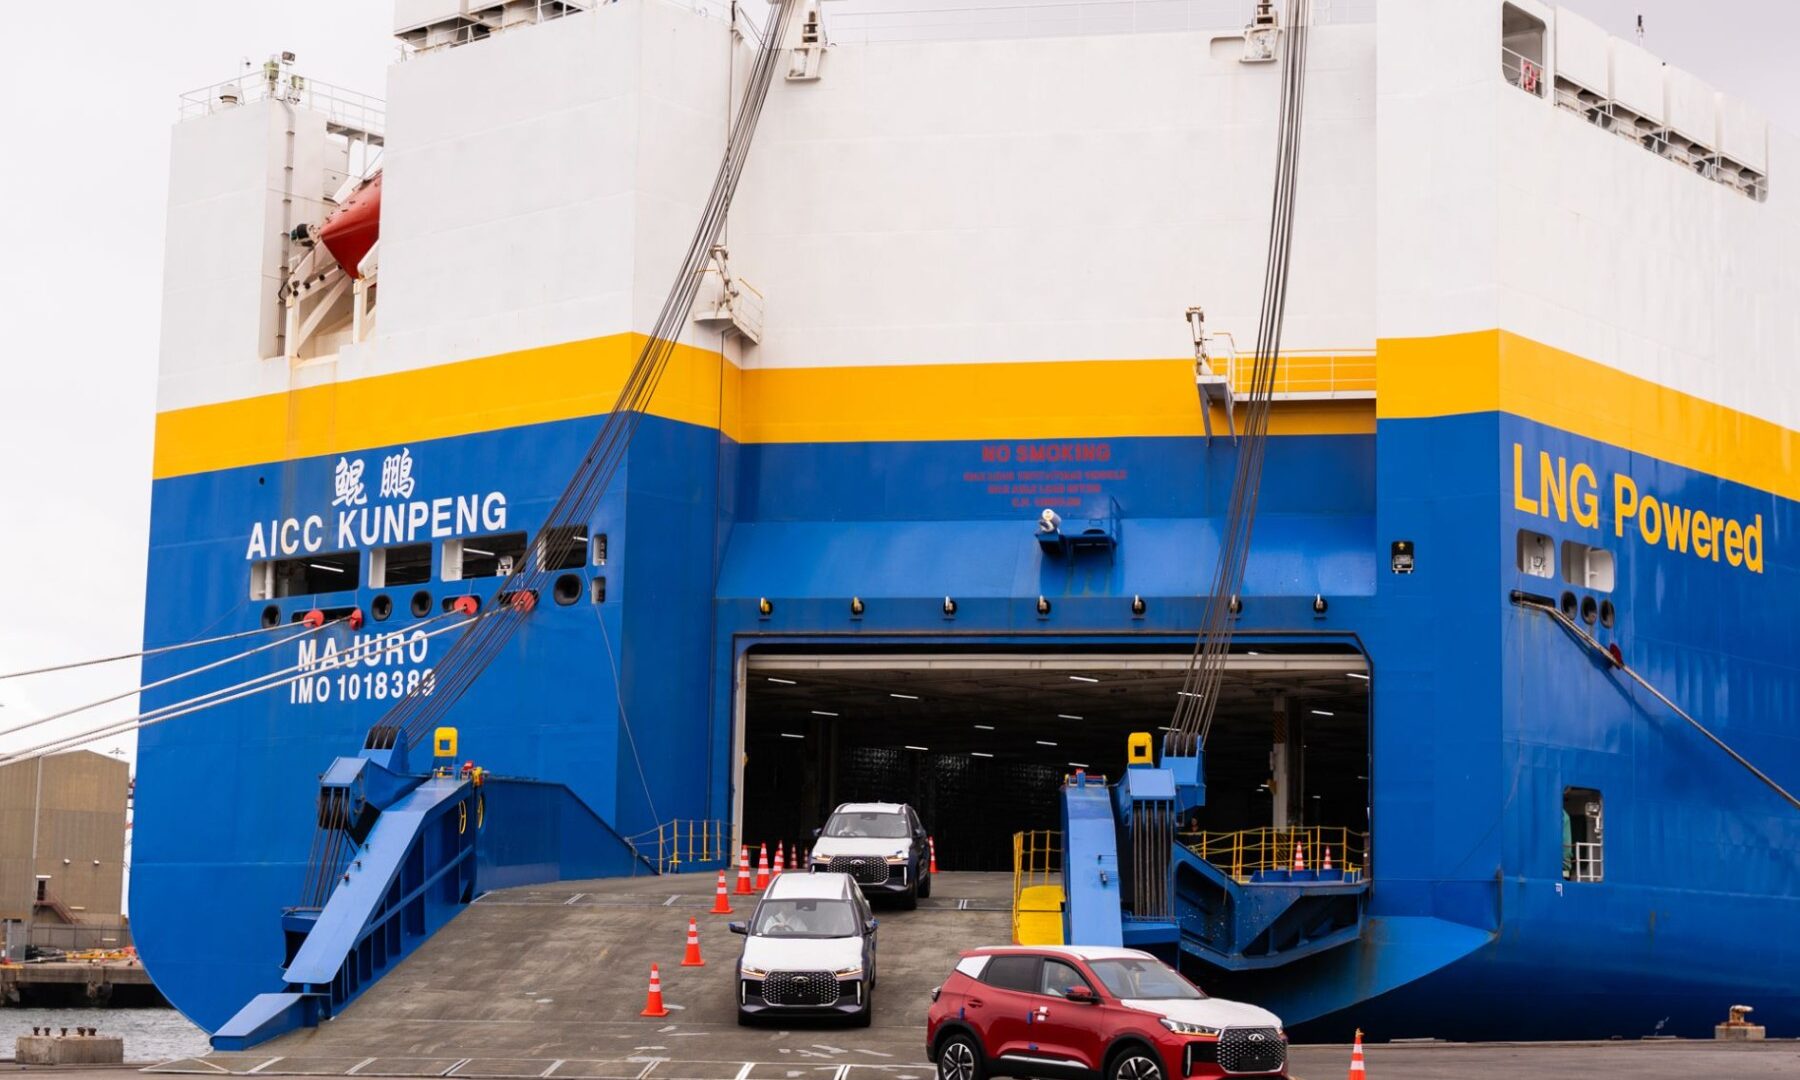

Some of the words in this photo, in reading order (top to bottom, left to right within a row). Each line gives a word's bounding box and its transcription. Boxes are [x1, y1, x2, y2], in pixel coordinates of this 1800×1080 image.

[982, 444, 1010, 462] NO
[1016, 443, 1111, 462] SMOKING
[246, 515, 323, 560] AICC
[338, 491, 507, 548] KUNPENG
[1514, 443, 1598, 529] LNG
[1614, 472, 1763, 574] Powered
[298, 629, 428, 672] MAJURO
[290, 675, 331, 704] IMO
